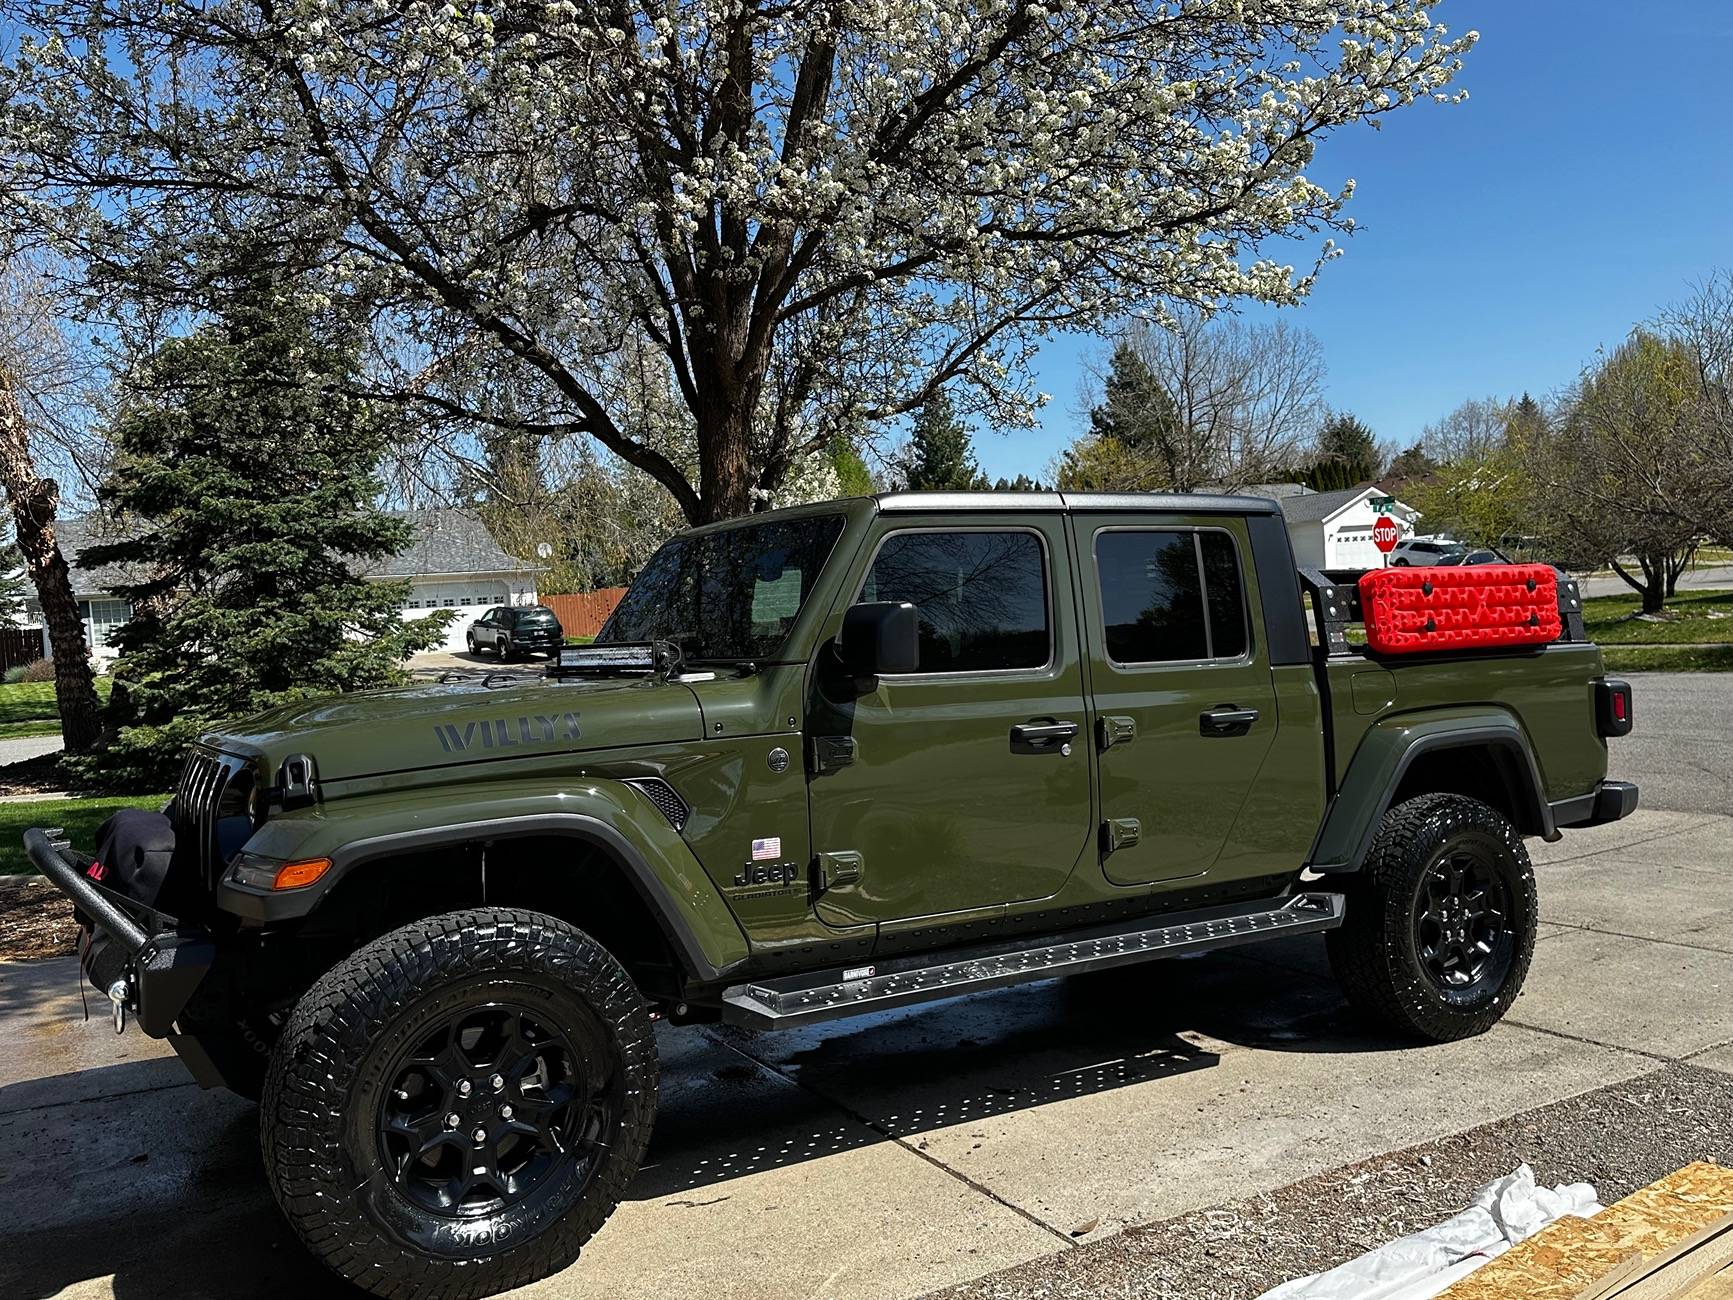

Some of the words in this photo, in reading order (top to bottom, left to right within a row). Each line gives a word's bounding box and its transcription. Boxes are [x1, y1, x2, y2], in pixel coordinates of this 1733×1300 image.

[1374, 527, 1397, 543] STOP
[433, 711, 583, 753] WILLYS
[734, 861, 799, 888] Jeep
[733, 888, 793, 901] GLADIATOR
